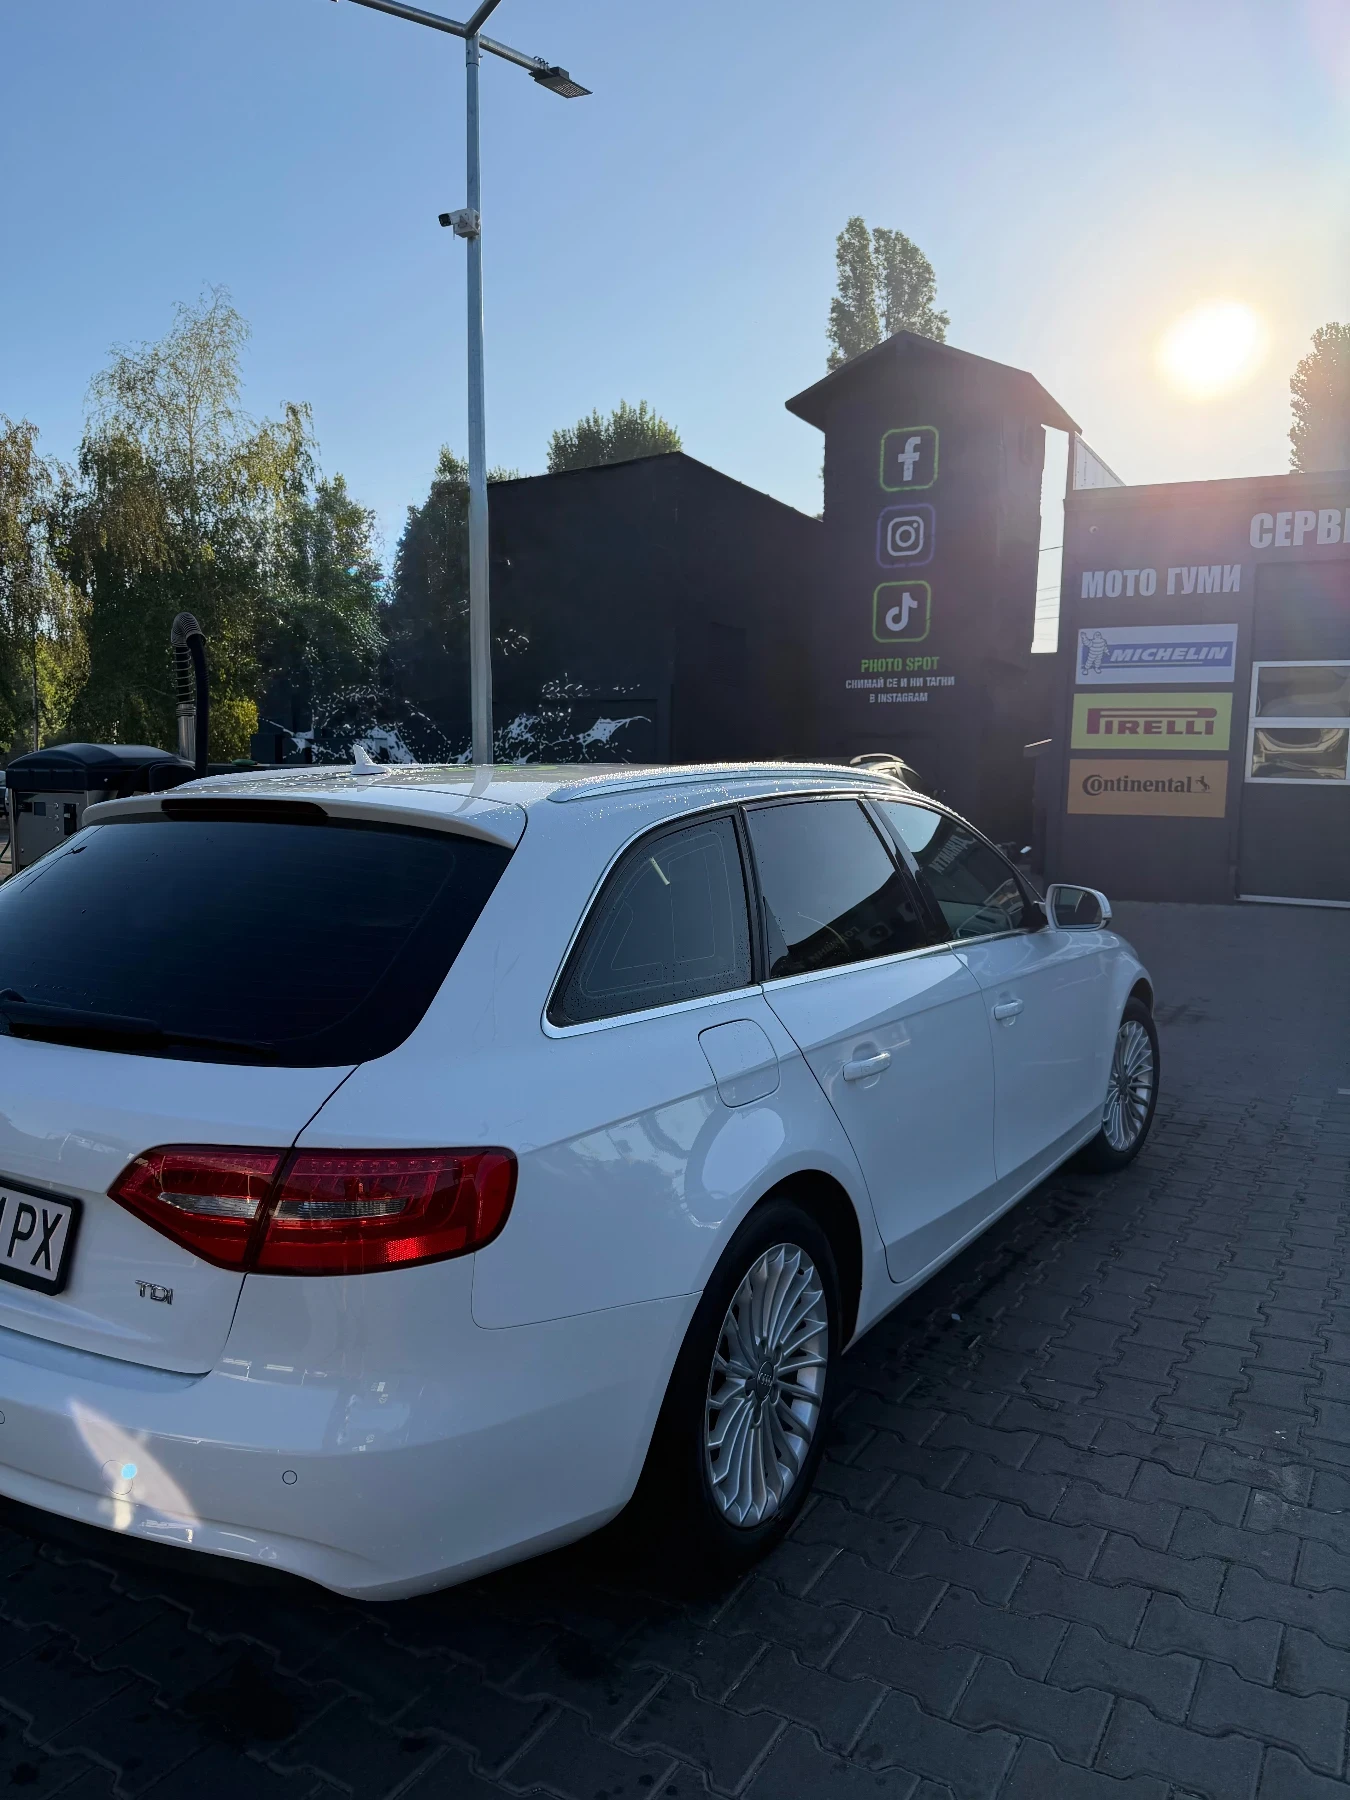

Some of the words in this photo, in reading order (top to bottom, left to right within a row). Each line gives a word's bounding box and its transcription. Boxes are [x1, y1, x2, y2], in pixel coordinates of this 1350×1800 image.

[1081, 568, 1157, 599] МОТО
[1166, 564, 1242, 595] ГУМИ
[1109, 646, 1228, 662] MICHELIN
[861, 658, 902, 672] PHOTO
[906, 656, 939, 671] SPOT
[845, 677, 884, 689] СНИМАЙ
[886, 678, 898, 688] СЕ
[900, 678, 908, 688] И
[910, 677, 923, 687] НИ
[926, 676, 955, 687] ТАГНИ
[878, 692, 928, 703] INSTAGRAM
[1086, 707, 1217, 735] PIRELLI
[1082, 774, 1192, 796] Continental
[135, 1279, 174, 1305] TDI
